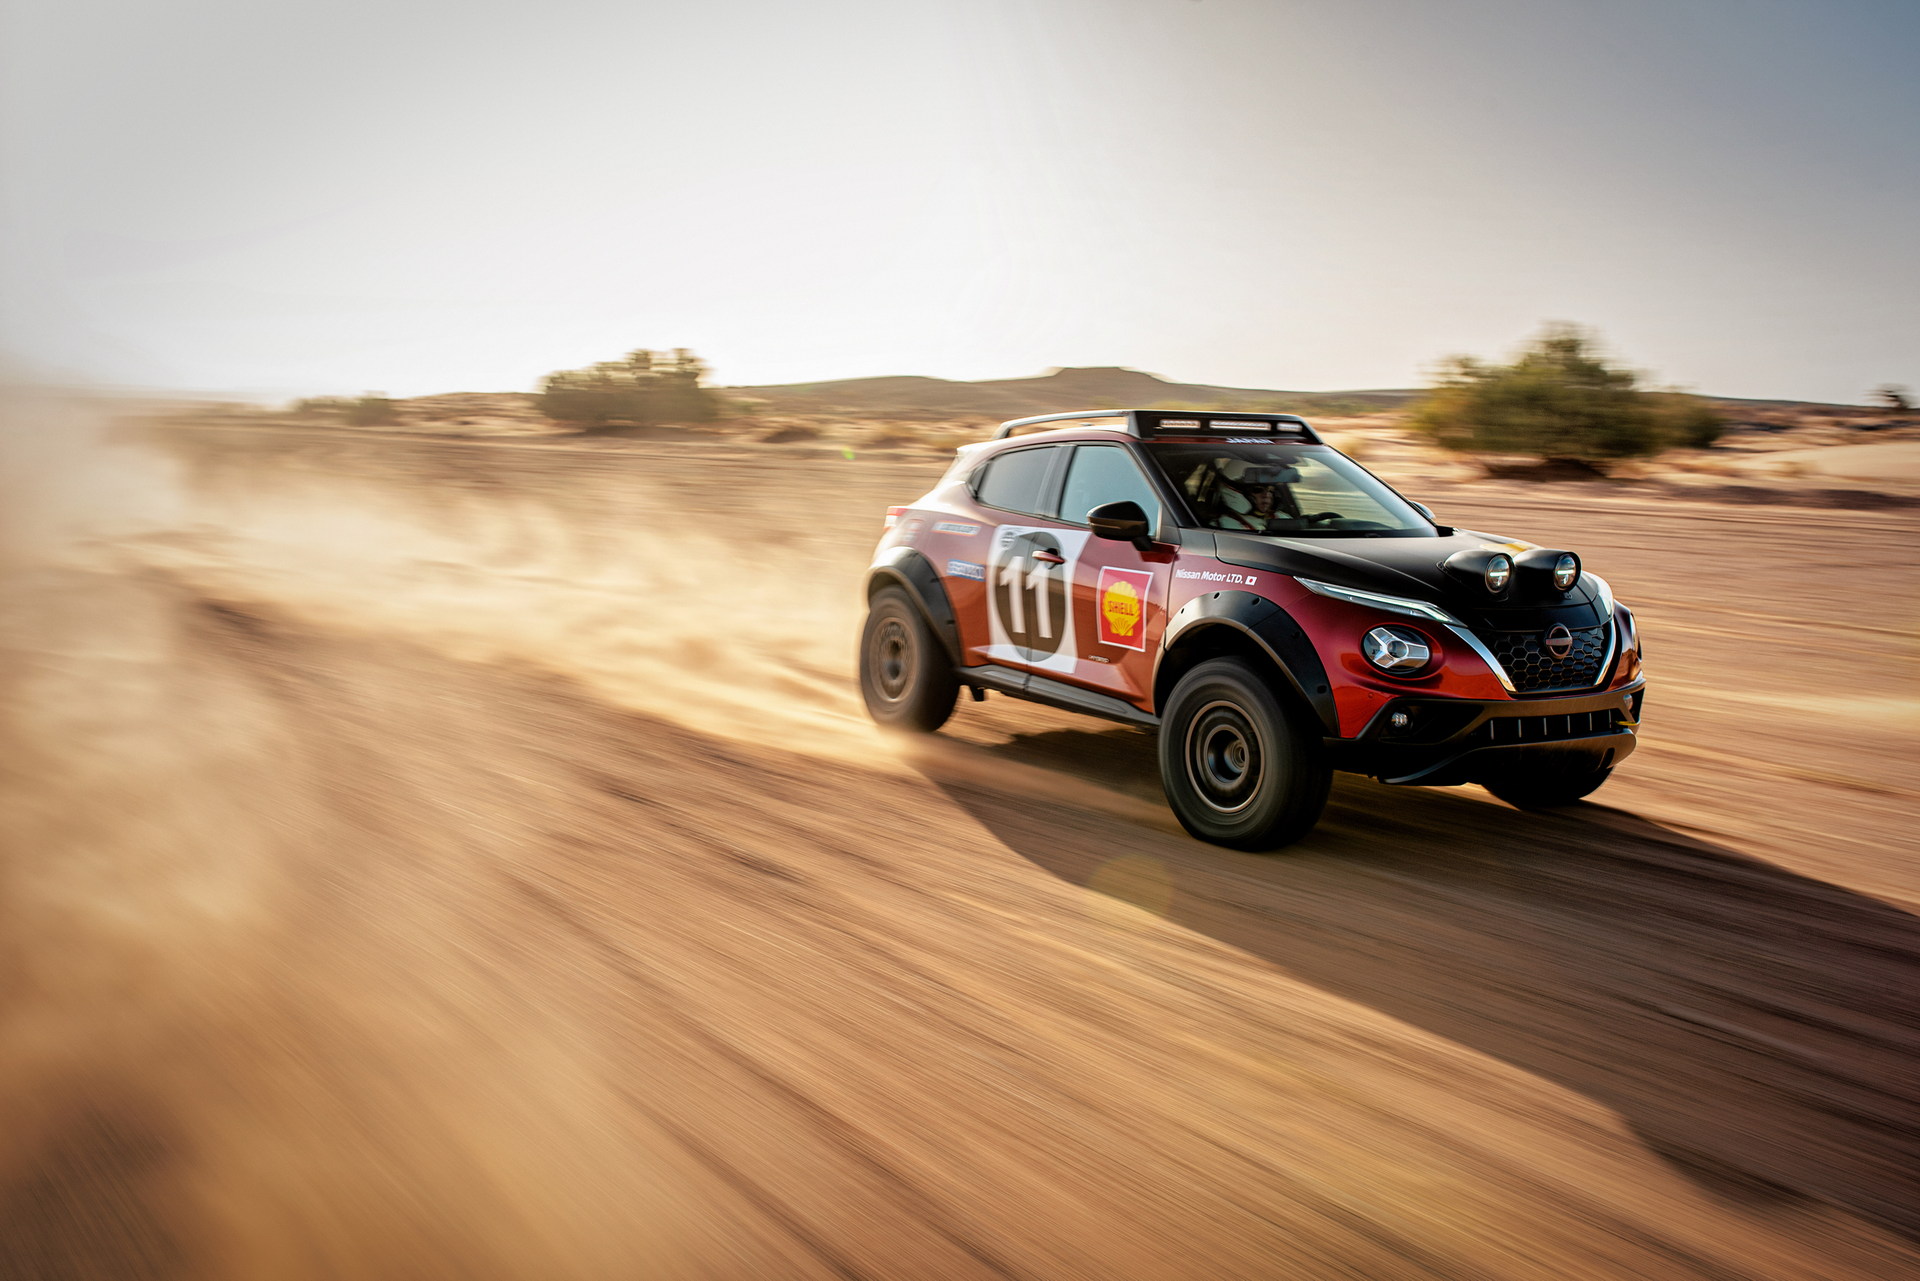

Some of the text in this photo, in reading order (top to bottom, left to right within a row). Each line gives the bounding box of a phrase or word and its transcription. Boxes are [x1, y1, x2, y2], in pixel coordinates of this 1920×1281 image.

[1175, 569, 1243, 584] Nissan Motor LTD.
[1000, 556, 1052, 638] 11
[1107, 600, 1135, 616] SHELL
